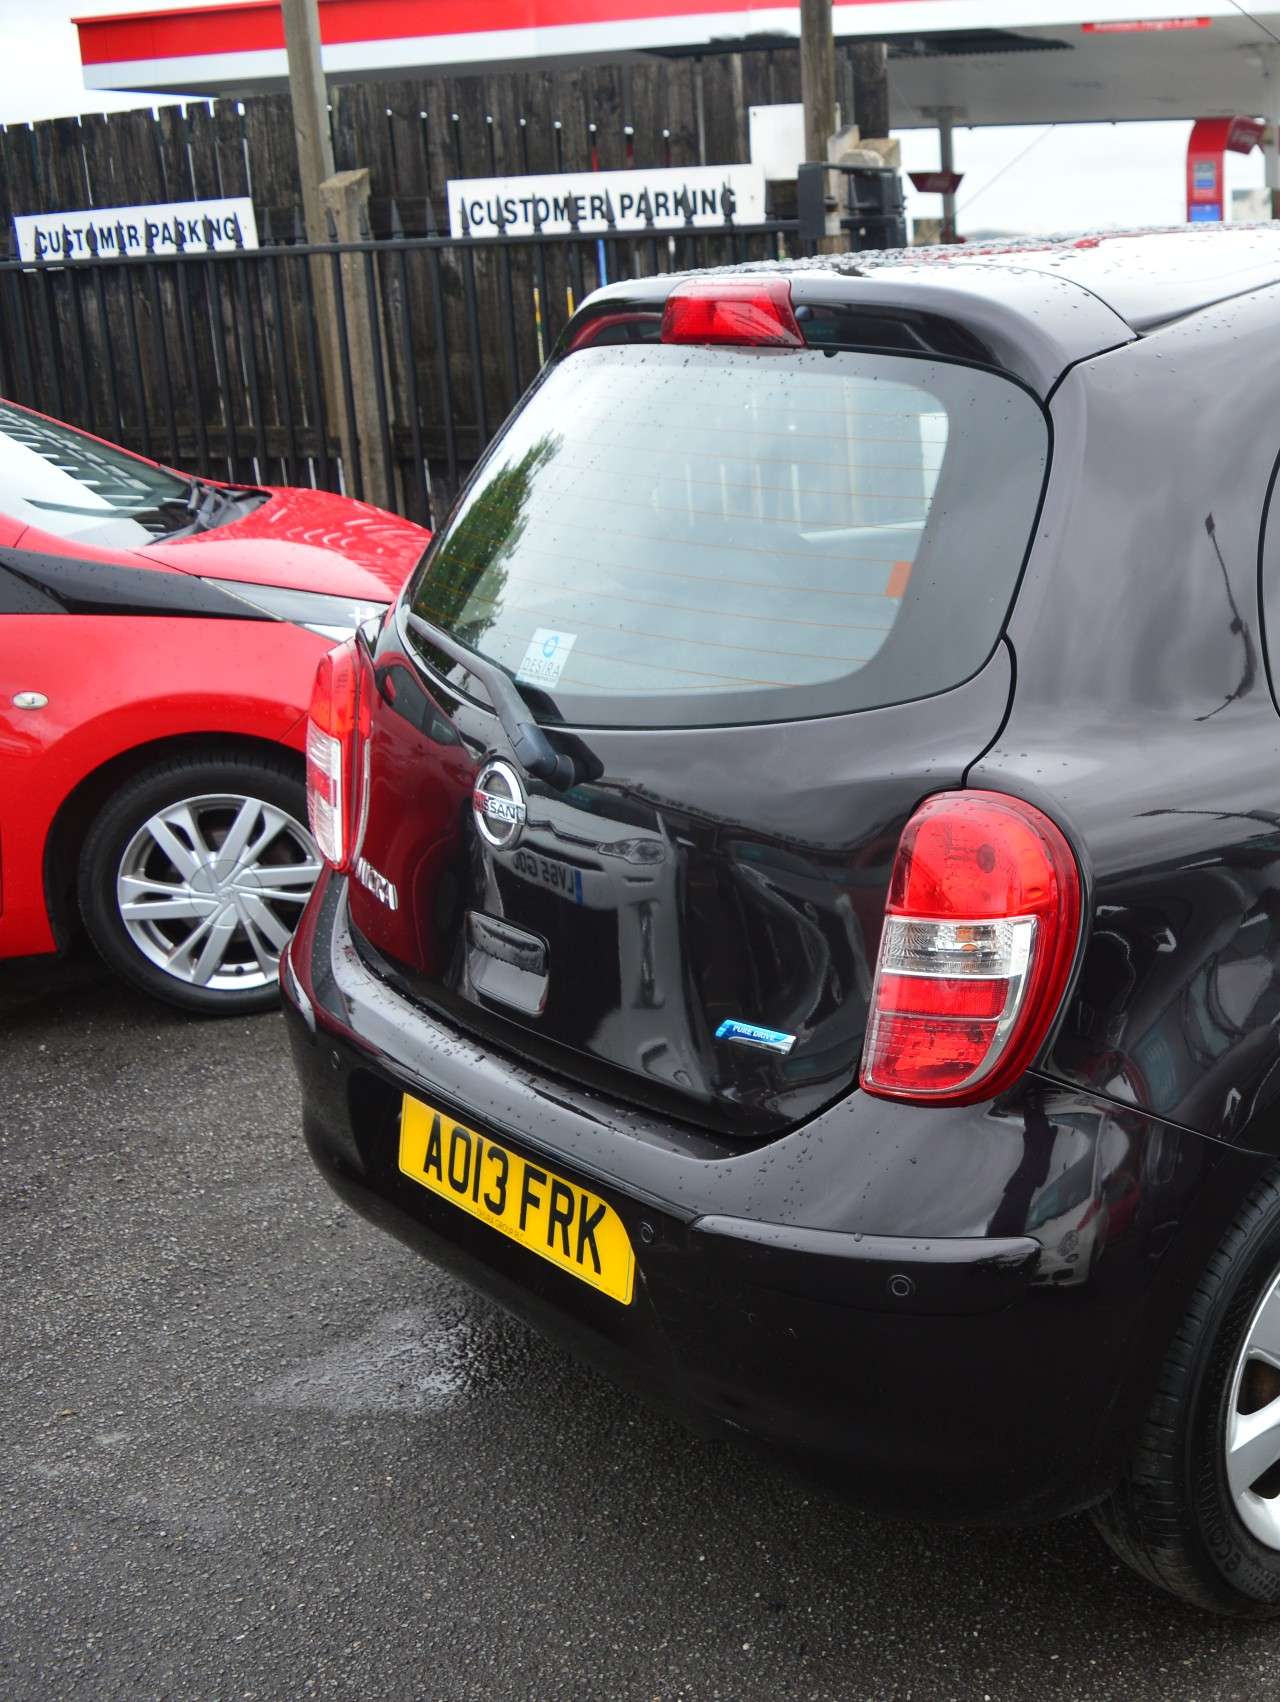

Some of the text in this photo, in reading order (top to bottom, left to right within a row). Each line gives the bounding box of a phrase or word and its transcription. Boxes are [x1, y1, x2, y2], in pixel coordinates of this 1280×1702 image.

[732, 1024, 753, 1036] PURE
[423, 1112, 607, 1276] AO13 FRK
